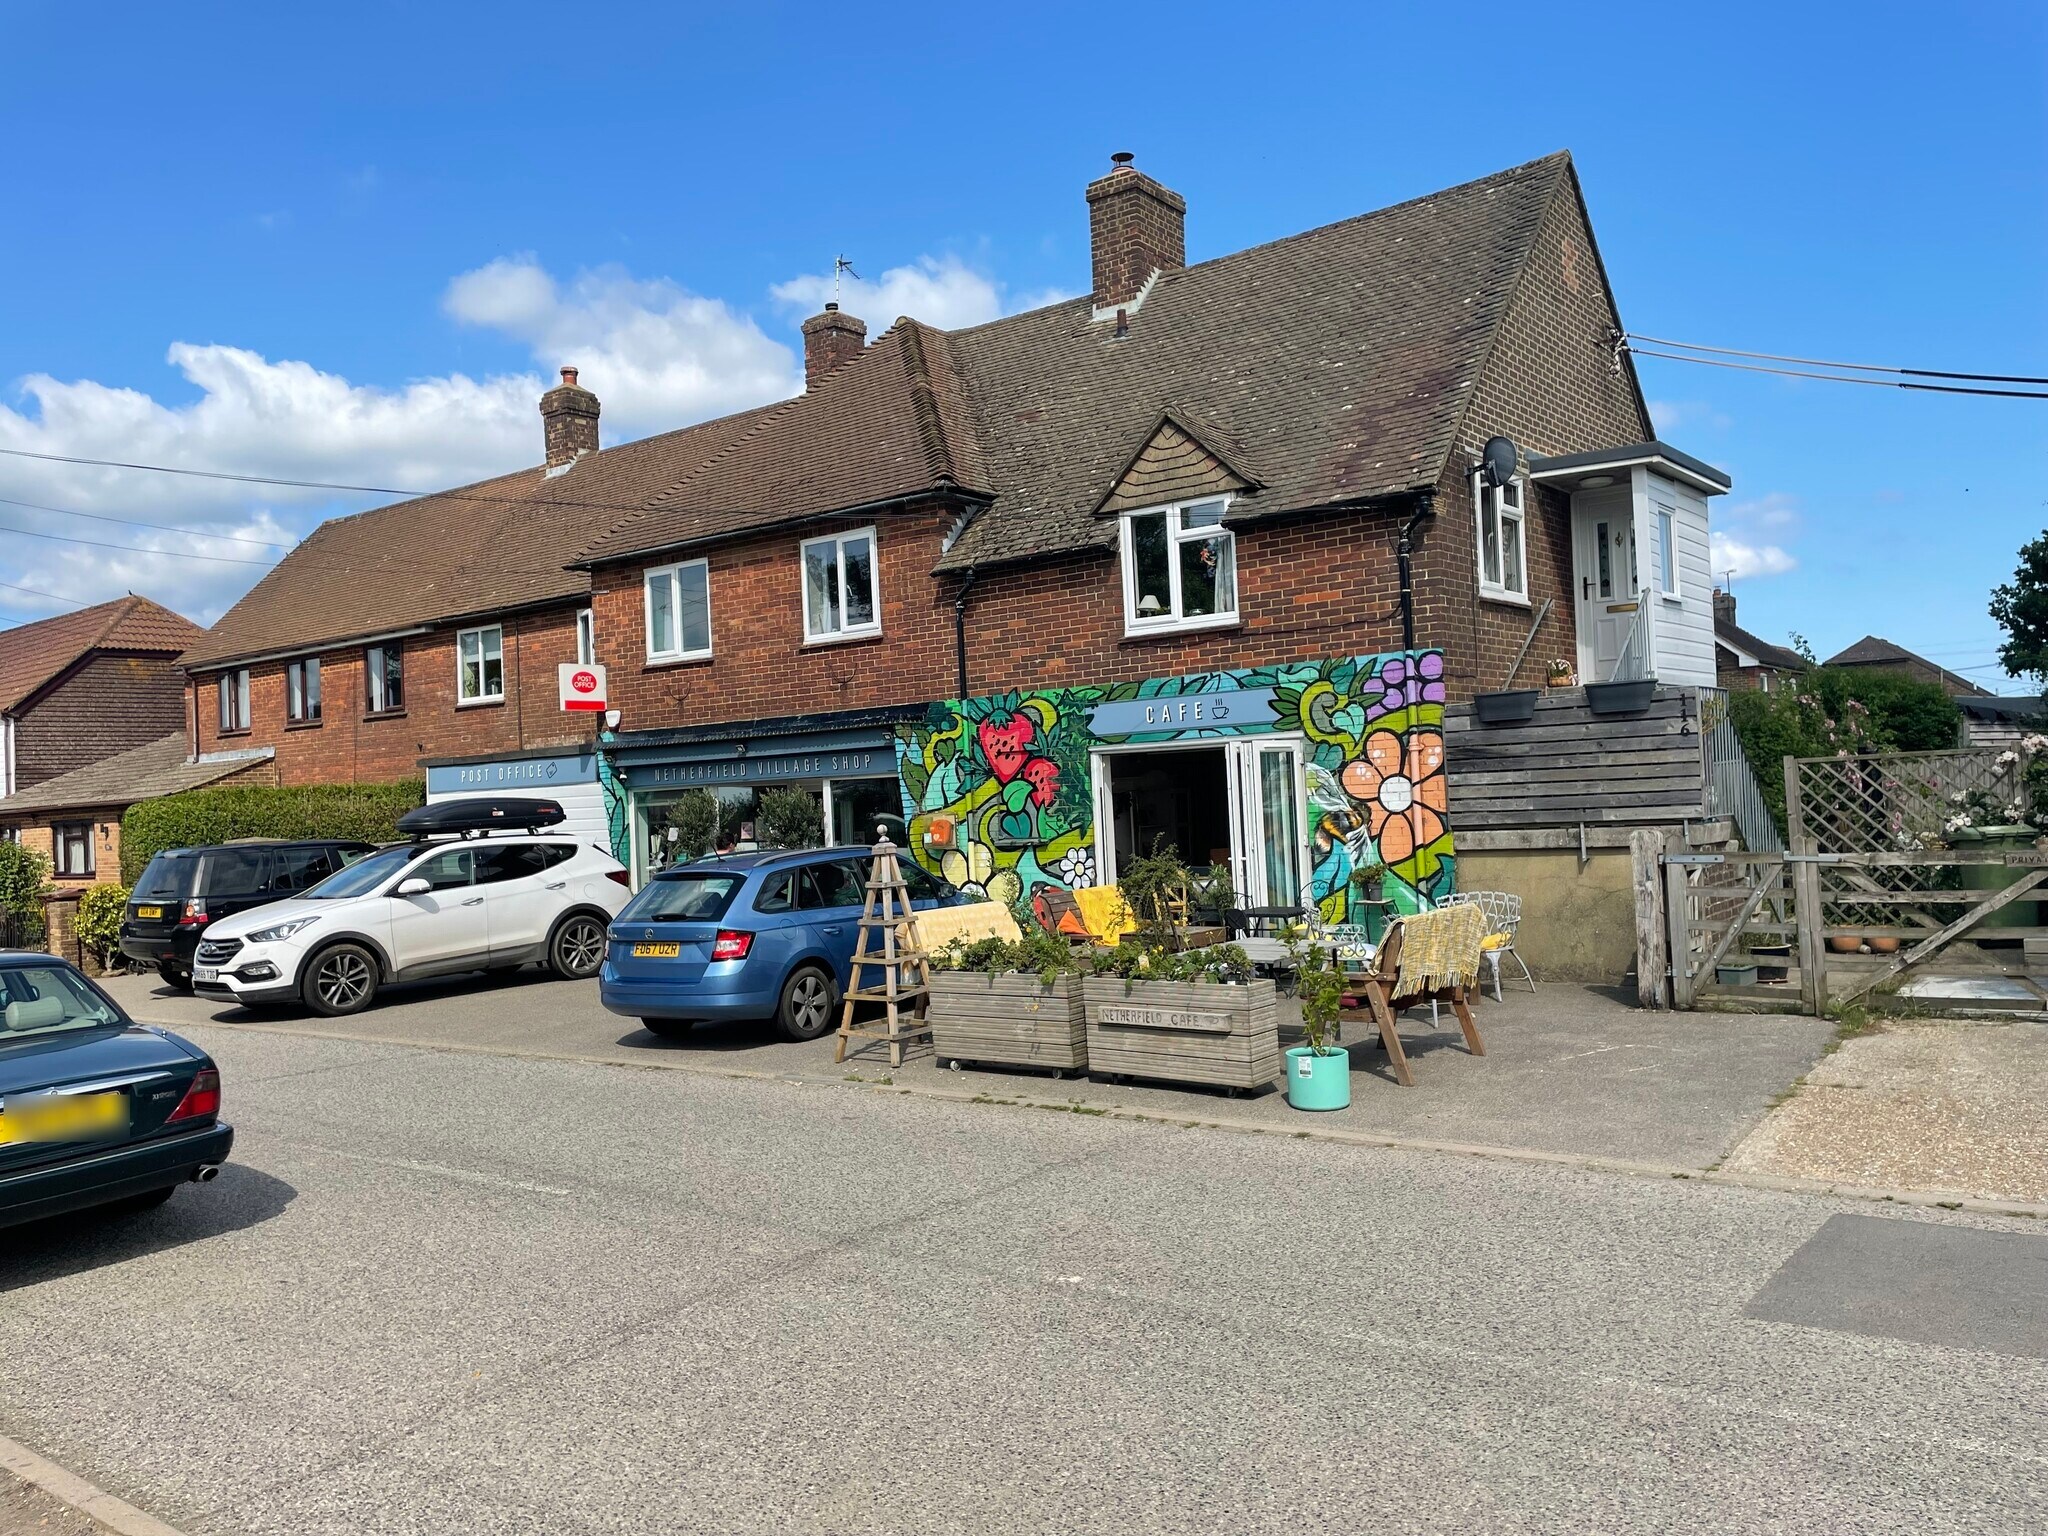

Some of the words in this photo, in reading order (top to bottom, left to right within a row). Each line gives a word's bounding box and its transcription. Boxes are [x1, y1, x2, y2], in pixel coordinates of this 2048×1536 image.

[574, 681, 594, 689] OFFICE
[1146, 702, 1203, 724] CAFE
[1680, 693, 1690, 737] 116
[461, 768, 490, 784] POST
[498, 764, 543, 781] OFFICE
[654, 763, 747, 782] NETHERFIELD
[757, 757, 820, 775] VILLAGE
[832, 754, 872, 770] SHOP
[2011, 856, 2048, 864] PRIVA
[659, 943, 677, 955] UZR
[1102, 1009, 1162, 1024] NETHERFIELD
